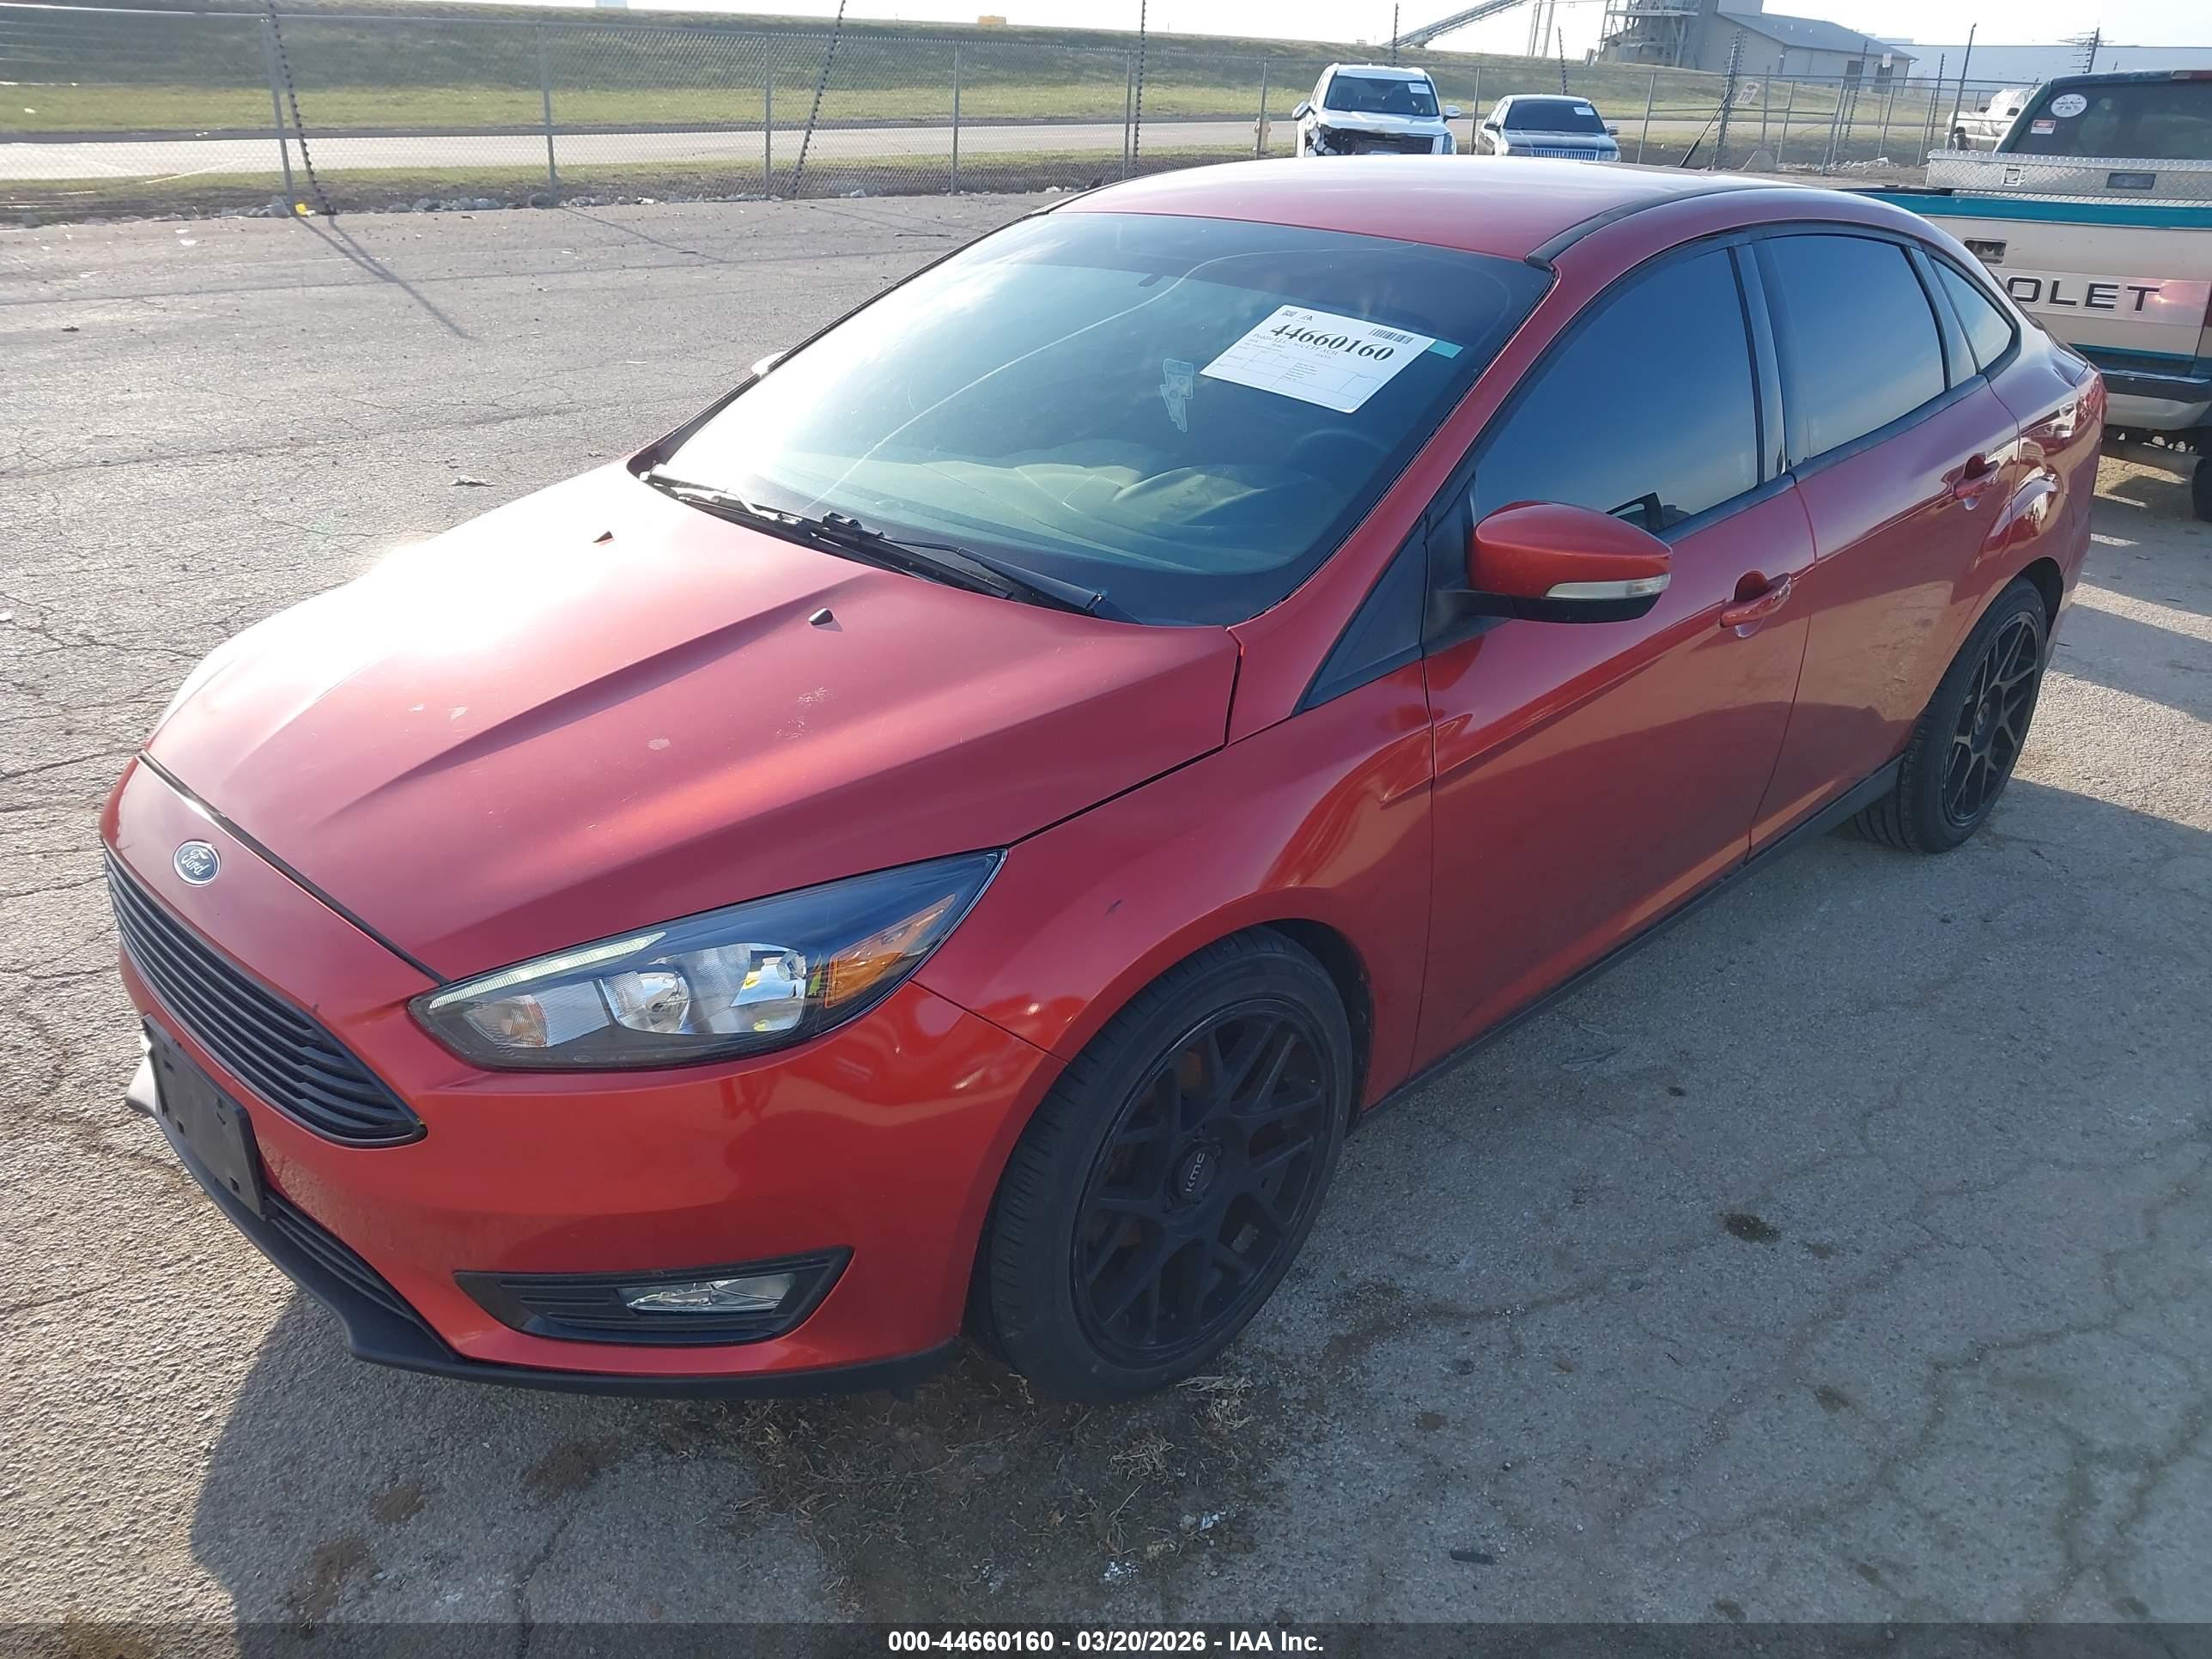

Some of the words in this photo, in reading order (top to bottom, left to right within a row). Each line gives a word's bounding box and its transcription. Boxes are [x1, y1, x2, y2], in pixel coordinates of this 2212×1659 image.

[2005, 276, 2161, 313] OLET
[1270, 324, 1395, 362] 44660160
[180, 848, 210, 876] Ford
